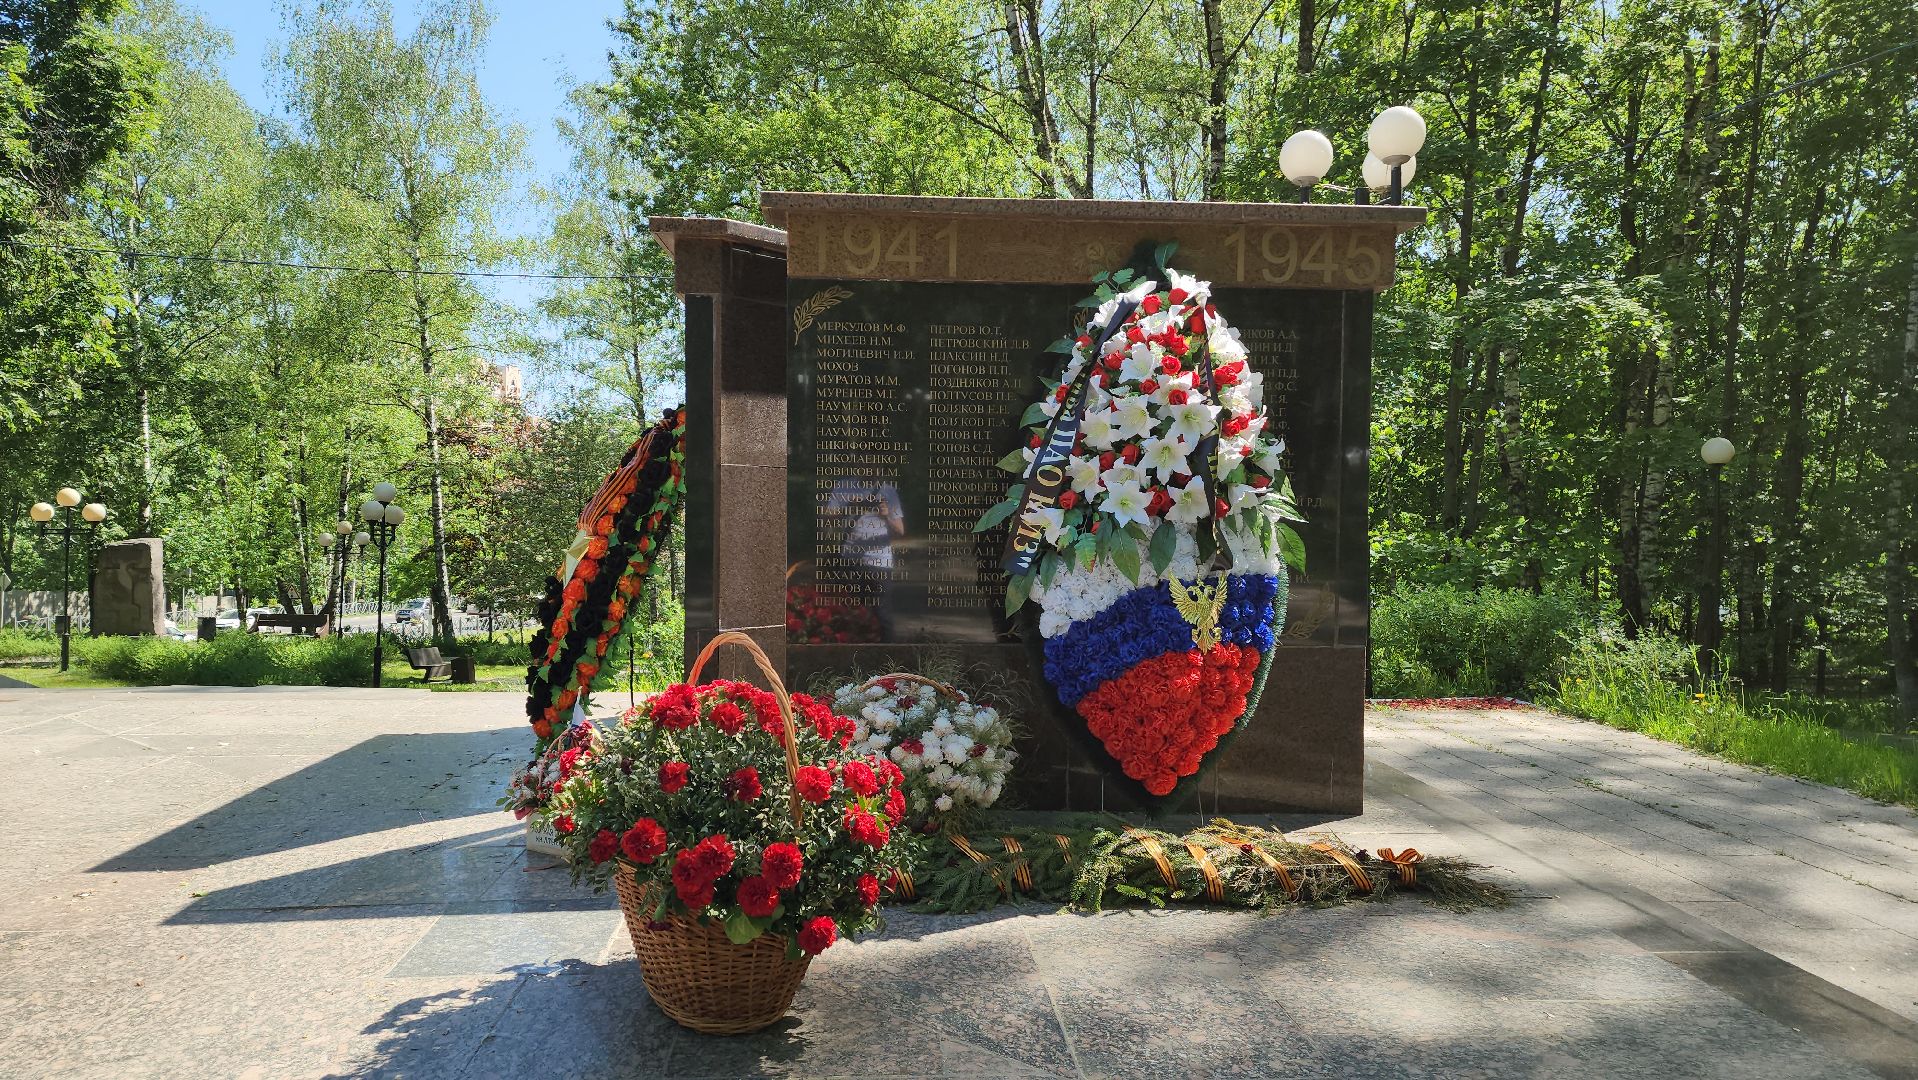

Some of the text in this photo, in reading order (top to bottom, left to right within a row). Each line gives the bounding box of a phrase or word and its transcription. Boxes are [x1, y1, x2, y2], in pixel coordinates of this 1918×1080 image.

[805, 220, 958, 277] 1941
[1224, 225, 1381, 285] 1945
[817, 322, 880, 332] МЕРКУЛОВ
[929, 325, 1002, 335] ПЕТРОВ Ю.Т.
[817, 335, 866, 344] МИХЕЕВ
[929, 336, 1007, 348] ПЕТРОВСКИЙ
[817, 348, 890, 359] МОГИЛЕВИЧ
[929, 352, 986, 361] ПЛАКСИН
[817, 362, 858, 371] МОХОВ
[929, 365, 986, 374] ПОГОНОВ
[816, 375, 901, 386] МУРАТОВ М.М.
[929, 378, 999, 388] ПОЗДНЯКОВ
[816, 388, 872, 398] МУРЕНЕВ
[929, 391, 992, 401] ПОЛТУСОВ
[816, 401, 908, 412] НАУМЕНКО А.С.
[929, 404, 984, 414] ПОЛЯКОВ
[816, 414, 892, 424] НАУМОВ В.В.
[929, 417, 984, 426] ПОЛЯКОВ
[816, 427, 867, 436] НАУМОВ
[929, 430, 970, 439] ПОПОВ
[816, 441, 890, 450] НИКИФОРОВ
[929, 443, 970, 452] ПОПОВ
[816, 454, 896, 464] НИКОЛАЕНКО
[1036, 426, 1077, 487] ПАО
[816, 467, 872, 476] НОВИКОВ
[929, 469, 982, 478] ПОЧАЕВА
[816, 480, 872, 489] НОВИКОВ
[929, 483, 998, 491] ПРОКОФЬЕВ
[929, 495, 1004, 504] ПРОХОРЕНКО
[928, 521, 974, 530] РАДИКО
[928, 547, 971, 557] РЕДЬКО
[816, 571, 887, 580] ПАХАРУКОВ
[816, 584, 860, 592] ПЕТРОВ
[816, 597, 860, 606] ПЕТРОВ
